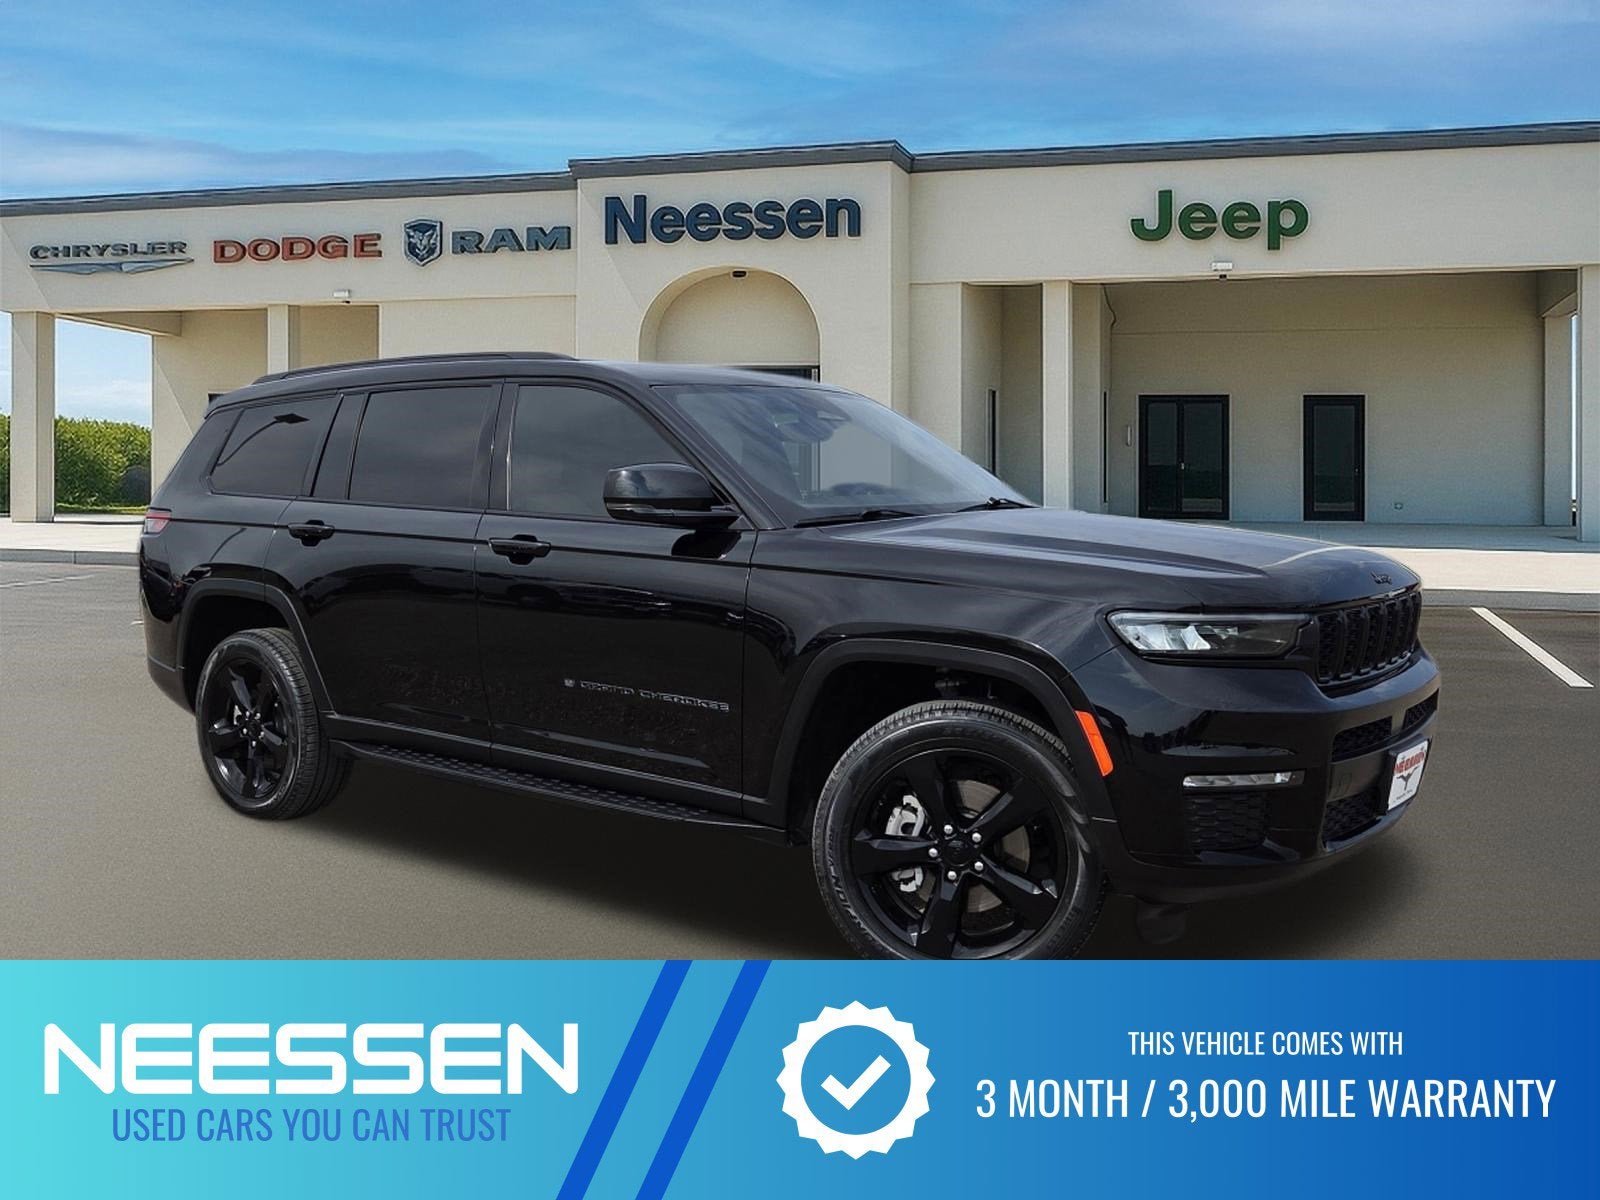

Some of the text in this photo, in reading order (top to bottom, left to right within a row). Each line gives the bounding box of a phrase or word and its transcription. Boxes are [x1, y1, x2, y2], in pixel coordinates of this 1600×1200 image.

[605, 195, 863, 245] Neessen
[1131, 189, 1309, 250] Jeep
[29, 240, 188, 260] CHRYSLER
[213, 233, 382, 264] DODGE
[451, 226, 571, 255] RAM
